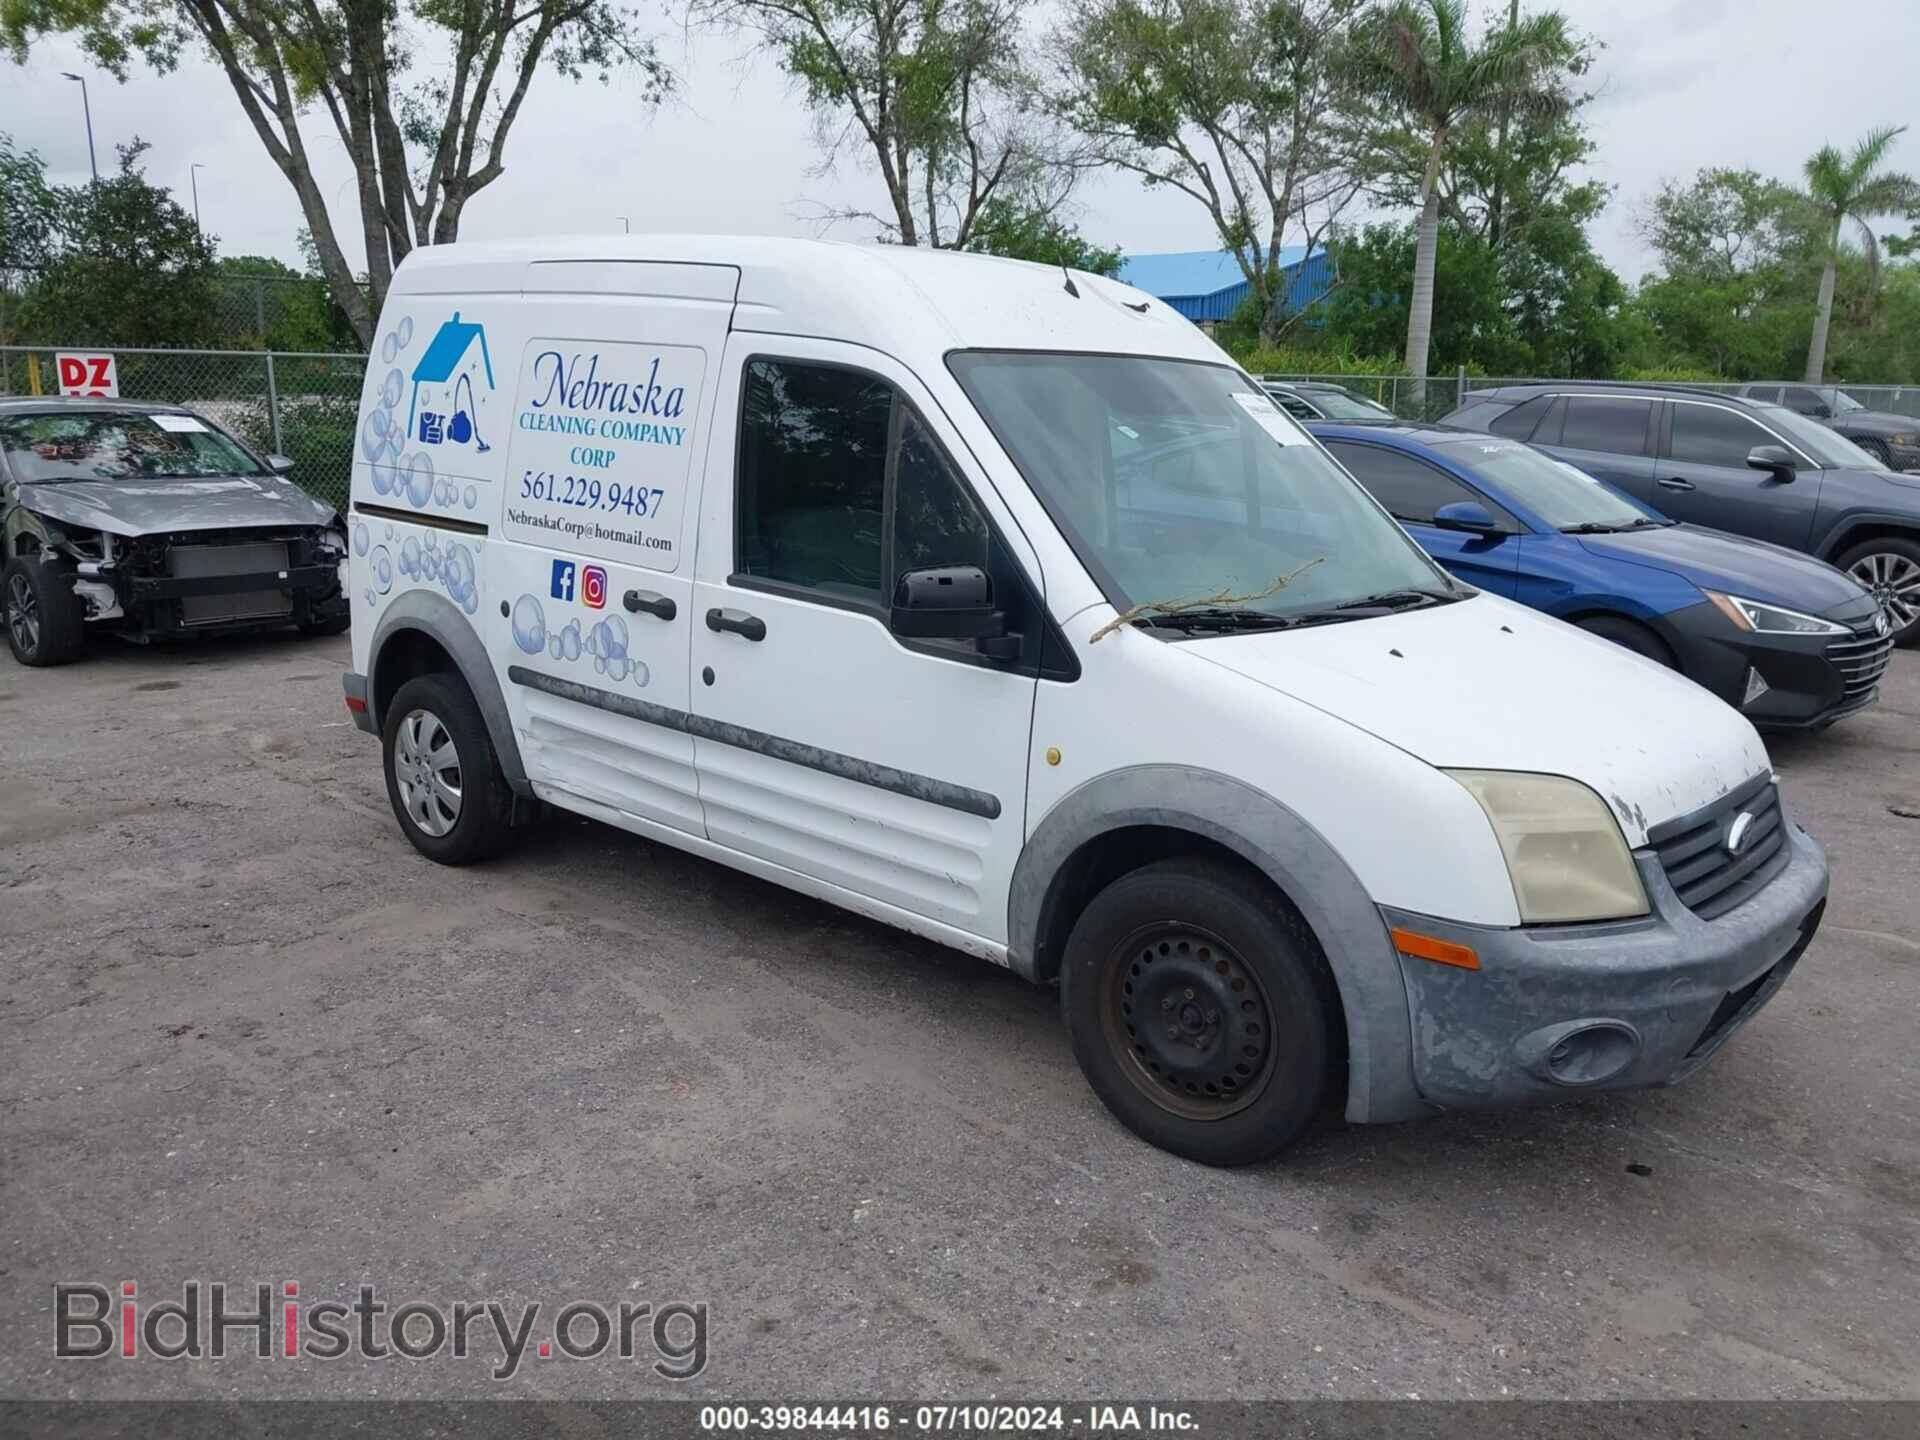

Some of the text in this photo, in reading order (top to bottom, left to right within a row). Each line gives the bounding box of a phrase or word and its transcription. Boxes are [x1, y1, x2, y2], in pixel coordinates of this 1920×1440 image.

[60, 358, 112, 388] DZ
[532, 351, 684, 418] Nebraska
[519, 411, 687, 447] CLEANING COMPANY
[570, 447, 616, 469] CORP
[520, 470, 664, 519] 561.229.9487
[507, 508, 673, 552] NebraskaCorp@hotmail.com
